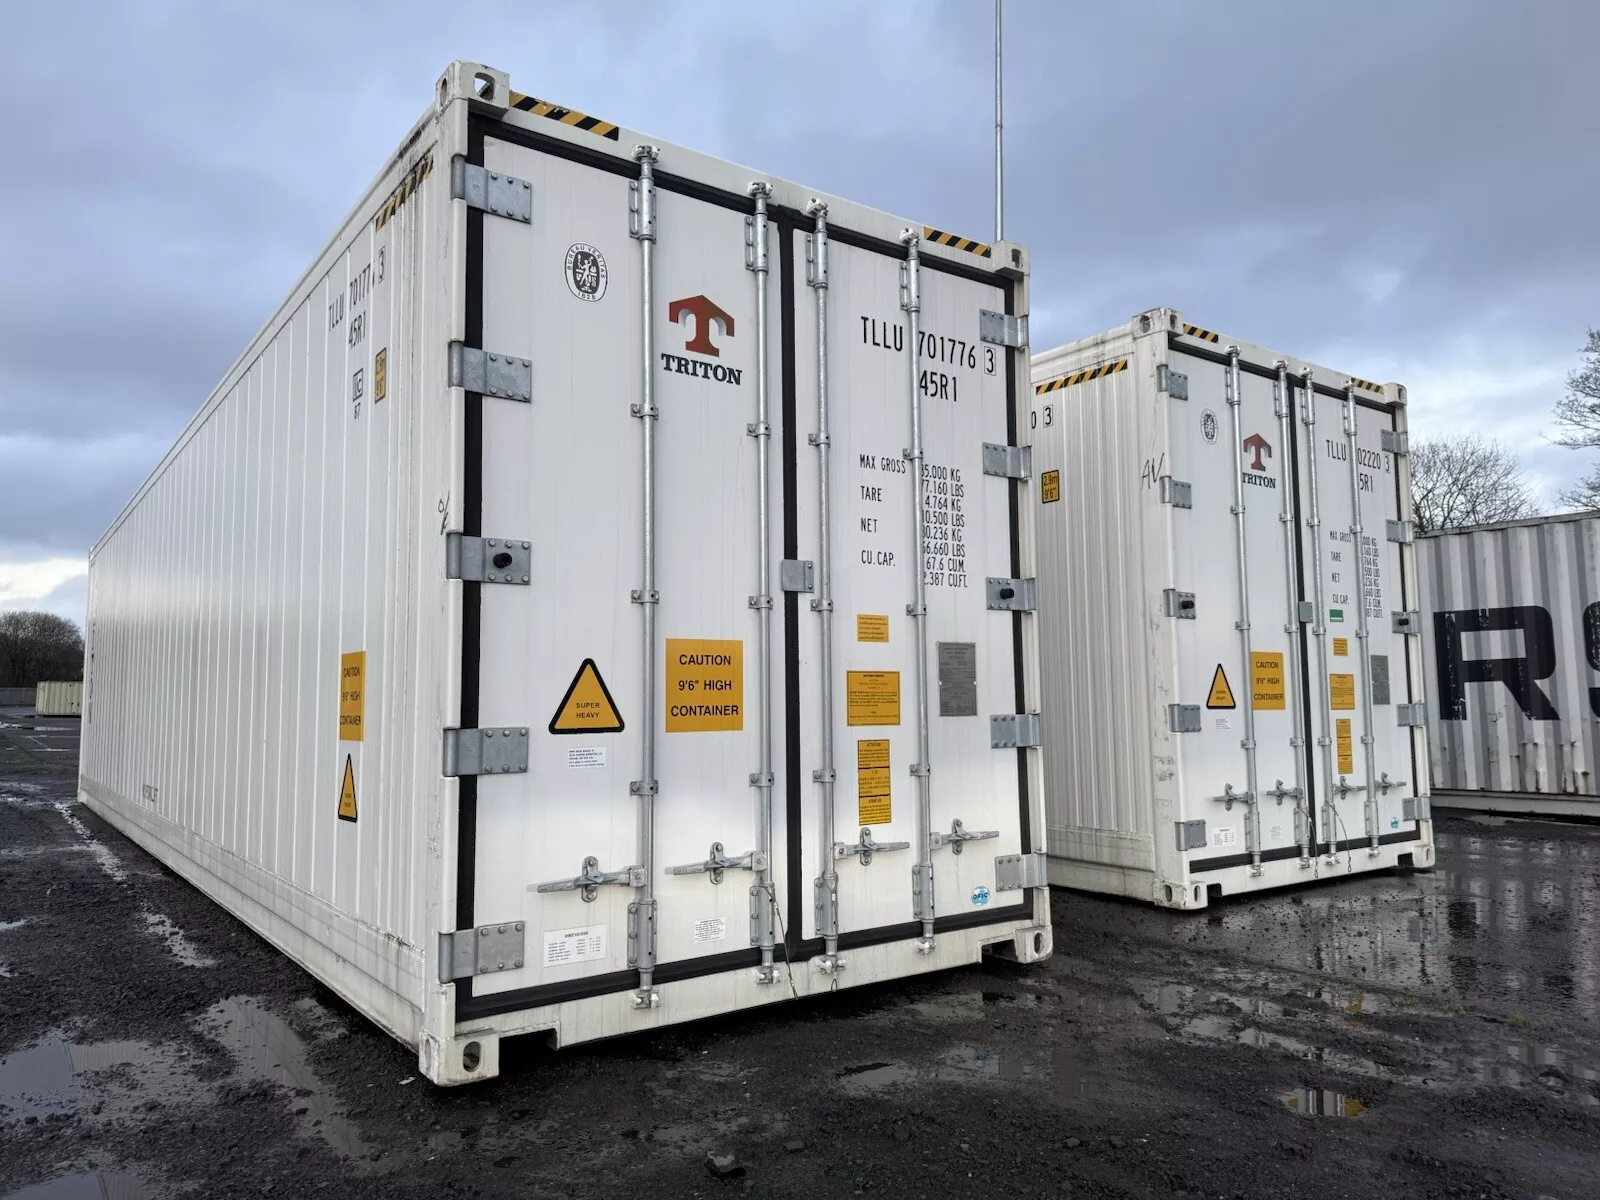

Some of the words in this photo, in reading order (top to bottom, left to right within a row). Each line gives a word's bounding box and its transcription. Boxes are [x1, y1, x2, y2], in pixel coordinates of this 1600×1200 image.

[567, 245, 584, 270] BUREAU
[588, 247, 606, 279] VERITAS
[329, 292, 344, 332] TLLU
[349, 310, 366, 349] 45R1
[861, 316, 902, 352] TLLU
[918, 331, 976, 369] 701776
[986, 348, 994, 374] 3
[661, 352, 742, 386] TRITON
[920, 370, 957, 402] 45R1
[1326, 440, 1346, 461] TLLU
[860, 454, 876, 470] MAX
[881, 457, 906, 474] GROSS
[951, 468, 960, 482] KG
[951, 483, 964, 497] LBS
[1242, 472, 1276, 489] TRITON
[1360, 473, 1373, 492] 5R1
[861, 486, 882, 502] TARE
[951, 498, 961, 512] KG
[861, 518, 877, 533] NET
[952, 528, 961, 542] KG
[952, 513, 964, 527] LBS
[952, 543, 965, 557] LBS
[926, 557, 944, 570] 67.6
[679, 654, 732, 665] CAUTION
[1434, 601, 1600, 720] R
[678, 680, 699, 691] 9'6"
[704, 680, 732, 690] HIGH
[670, 705, 739, 716] CONTAINER
